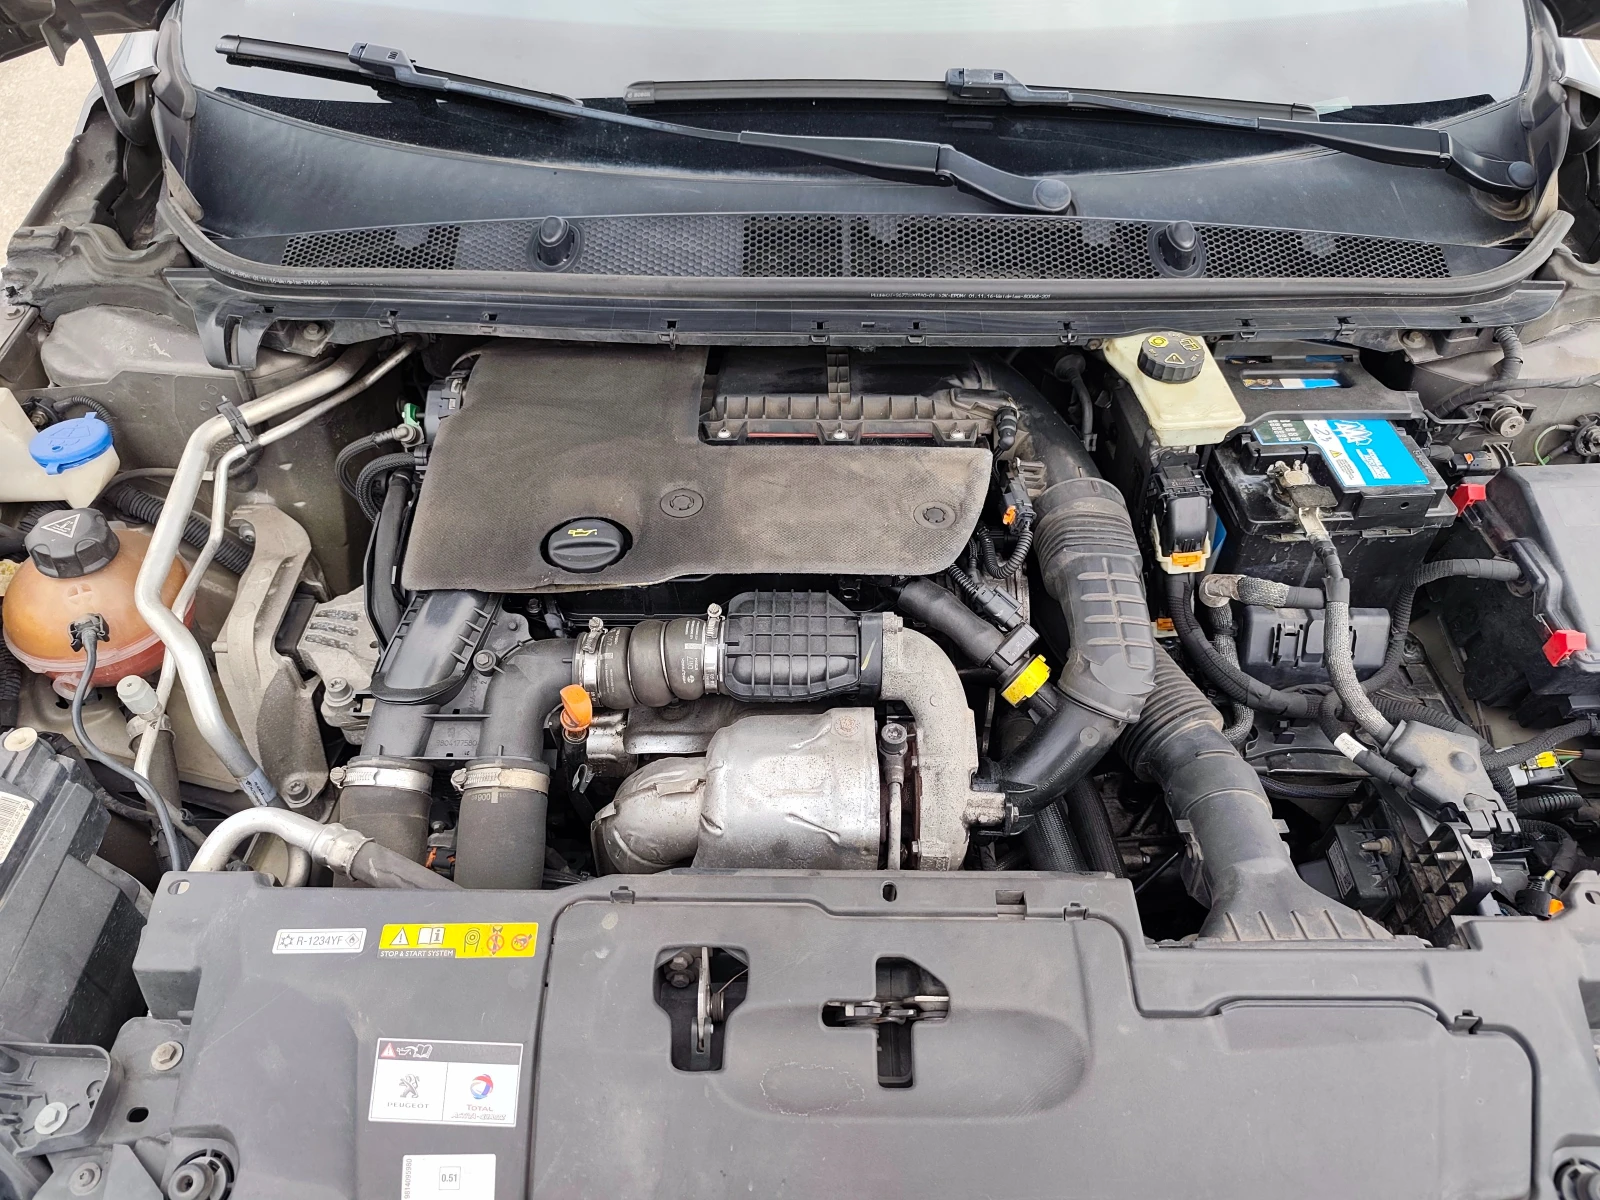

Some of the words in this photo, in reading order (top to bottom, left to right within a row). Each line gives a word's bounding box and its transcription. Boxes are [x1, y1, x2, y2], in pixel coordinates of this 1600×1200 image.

[296, 935, 344, 946] R-1234YF
[427, 949, 454, 957] SYSTEM
[387, 1101, 430, 1109] PEUGEOT
[441, 1173, 458, 1183] 0.51
